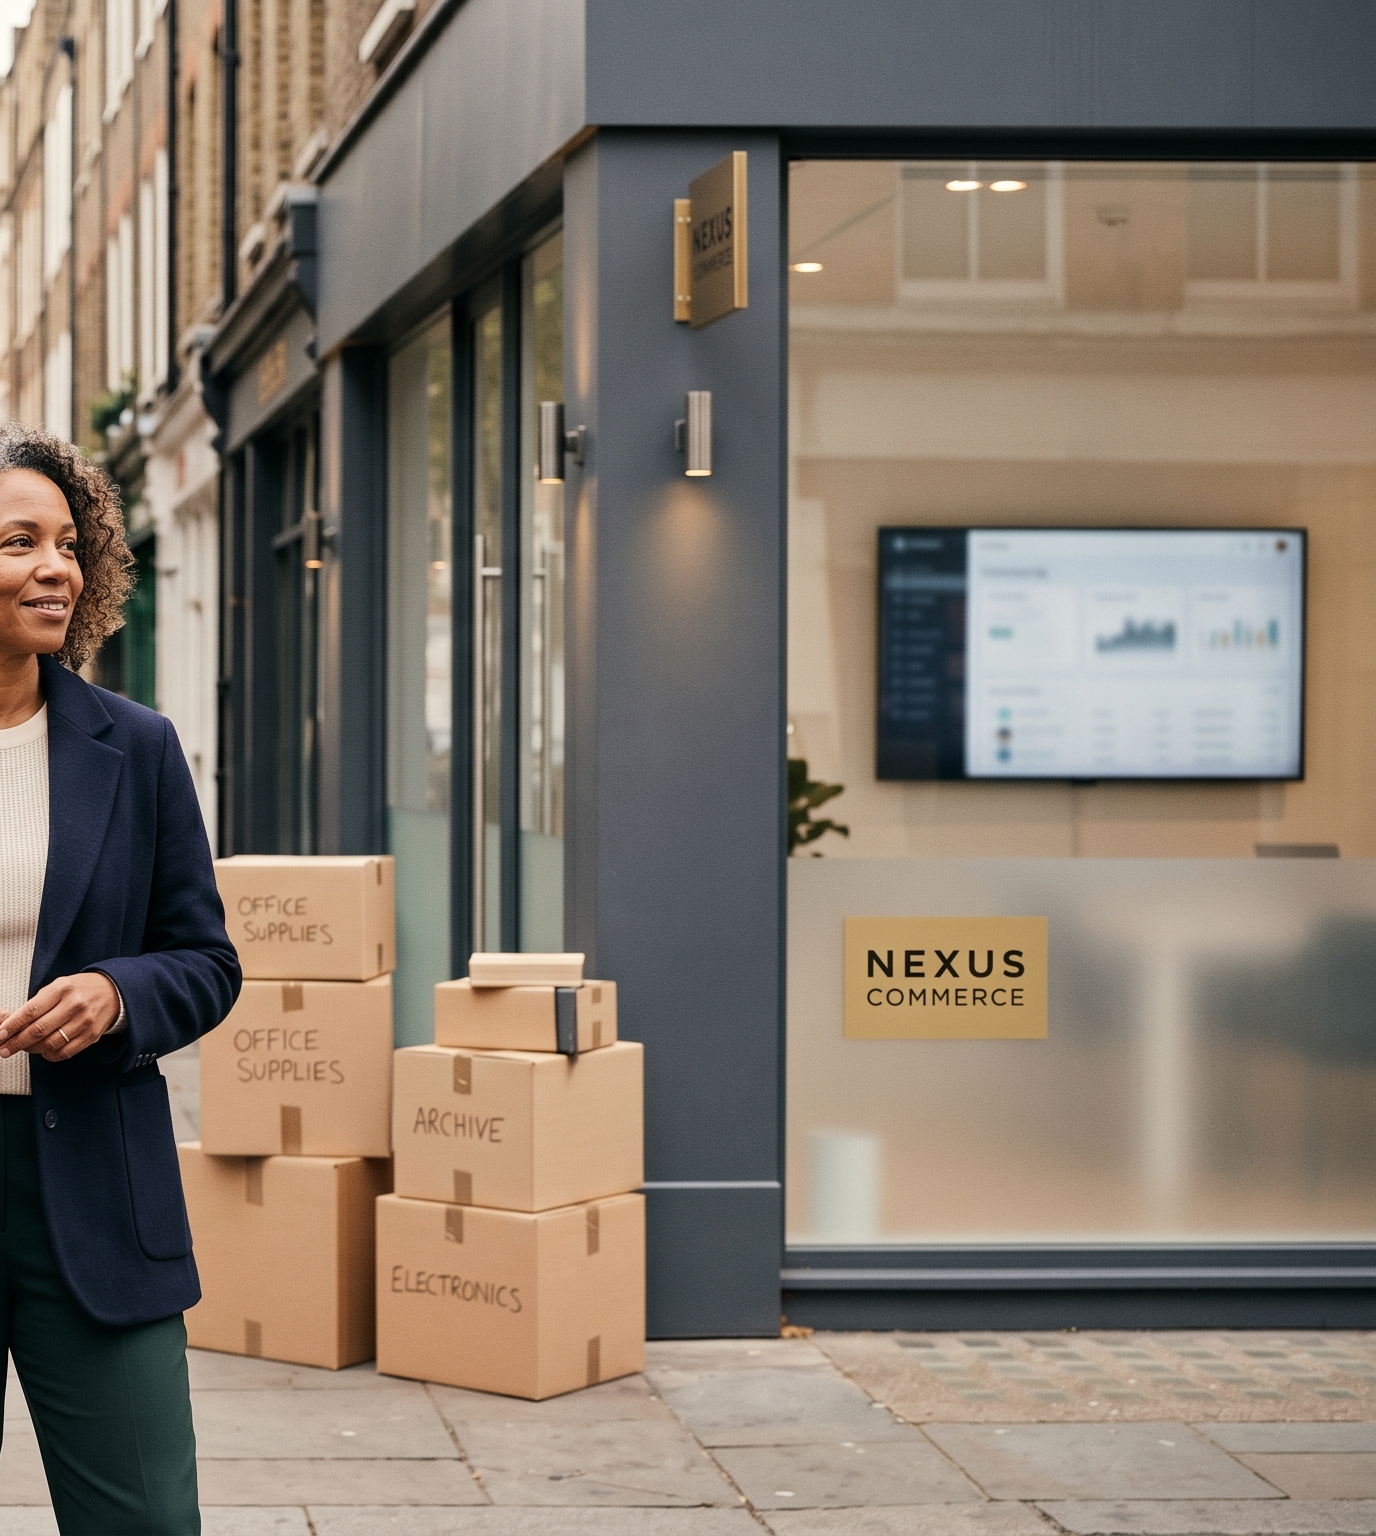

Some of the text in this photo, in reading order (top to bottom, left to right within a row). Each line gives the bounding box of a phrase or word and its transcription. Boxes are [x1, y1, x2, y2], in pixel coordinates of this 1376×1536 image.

[692, 205, 732, 250] NEXUS
[237, 895, 308, 917] OFFICE
[243, 921, 334, 945] SUPPLIES
[867, 949, 1025, 978] NEXUS
[866, 988, 1024, 1006] COMMERCE
[233, 1028, 319, 1053] OFFICE
[237, 1057, 345, 1085] SUPPLIES
[413, 1106, 505, 1143] ARCHIVE
[390, 1264, 523, 1314] ELECTRONICS
